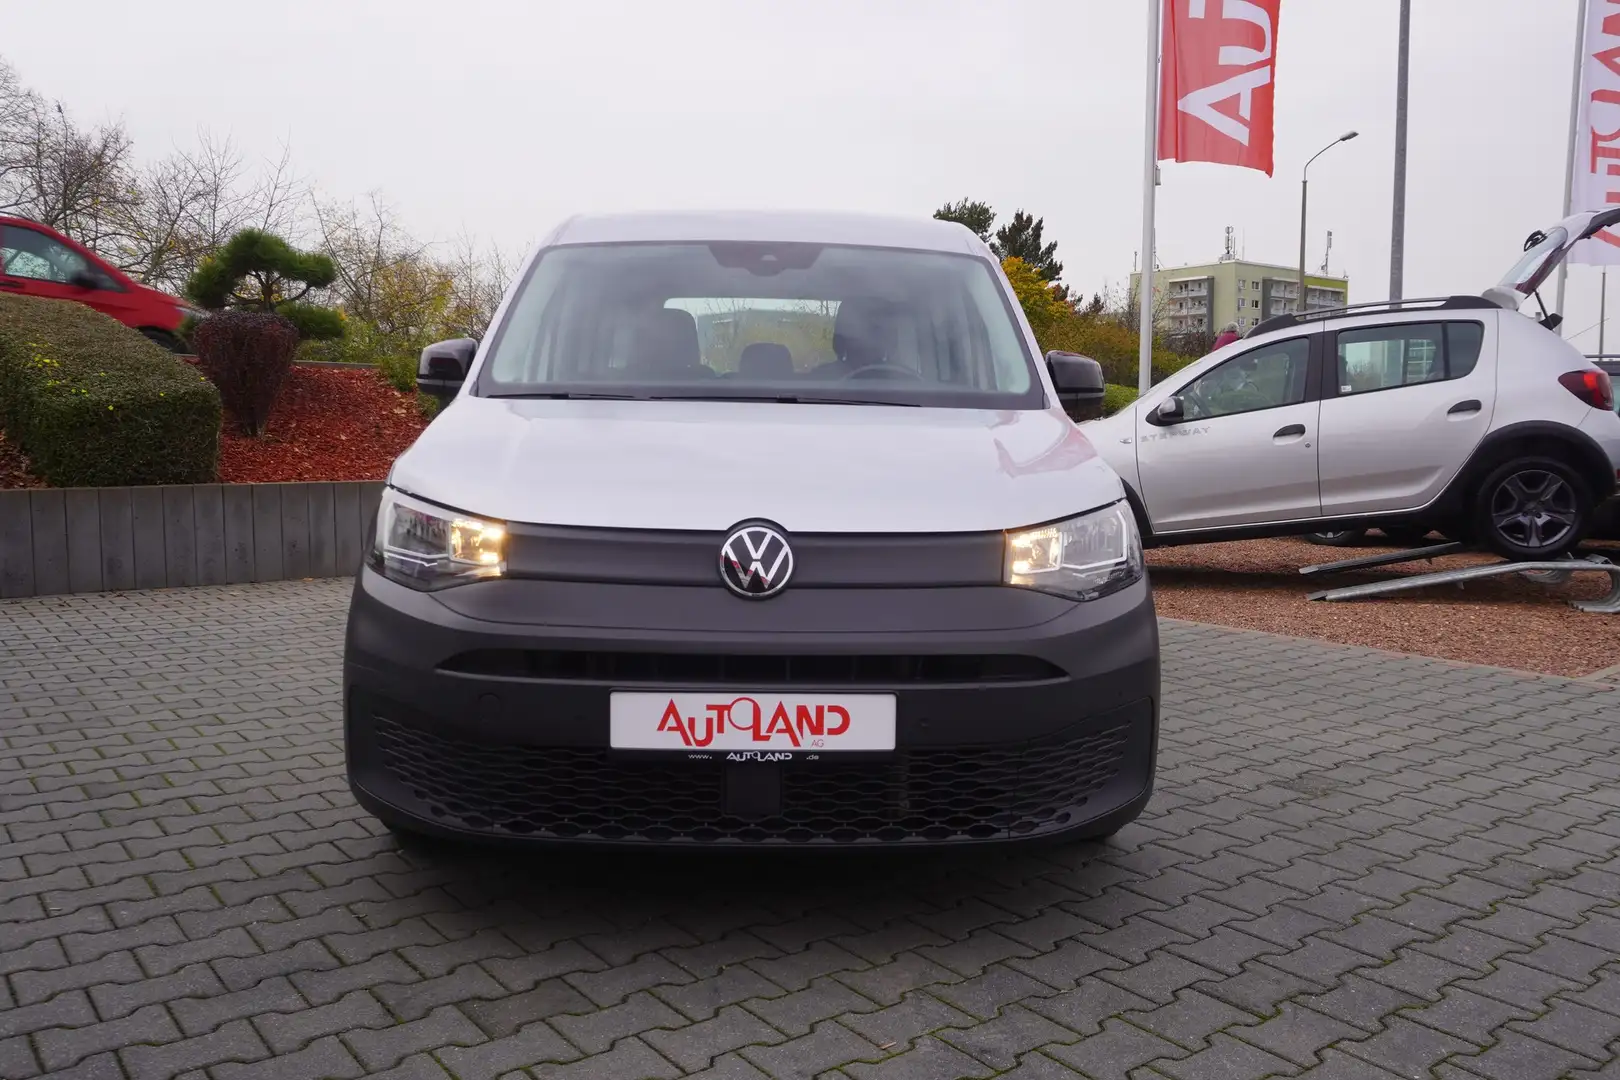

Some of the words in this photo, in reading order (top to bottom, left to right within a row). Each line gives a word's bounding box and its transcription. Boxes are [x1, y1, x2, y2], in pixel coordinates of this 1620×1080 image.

[1177, 0, 1272, 147] AU
[1140, 426, 1211, 442] STEPWAY
[811, 739, 824, 748] AG
